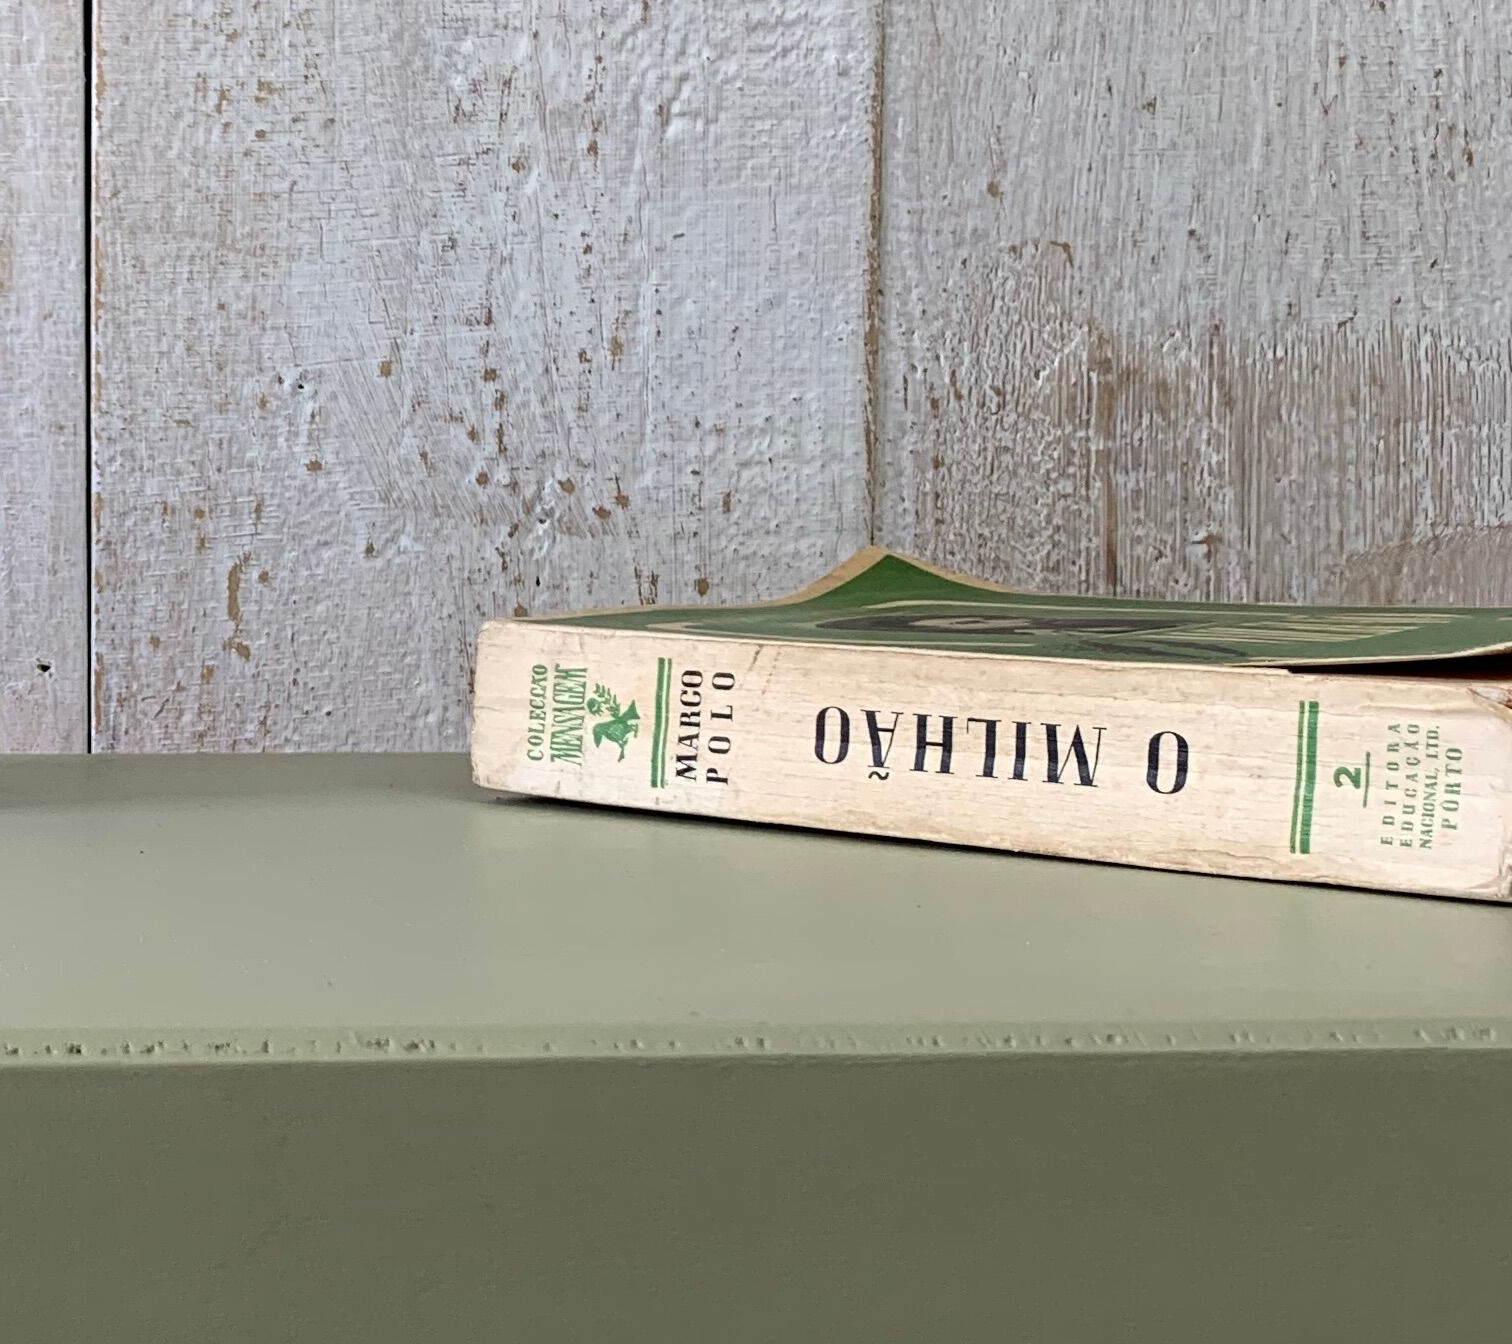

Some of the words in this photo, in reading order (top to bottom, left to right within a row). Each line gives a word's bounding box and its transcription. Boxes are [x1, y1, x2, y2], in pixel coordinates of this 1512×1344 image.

[550, 663, 588, 766] MENSAGEM
[676, 670, 703, 781] MARCO
[706, 672, 735, 784] POLO
[814, 706, 1107, 788] MILHÃO
[1426, 724, 1441, 760] LTD.
[1146, 731, 1189, 795] O
[1333, 766, 1363, 790] 2
[1380, 723, 1401, 846] EDITORA
[1400, 724, 1420, 848] EDUCAÇÃO
[1420, 768, 1440, 849] NACIONAL,
